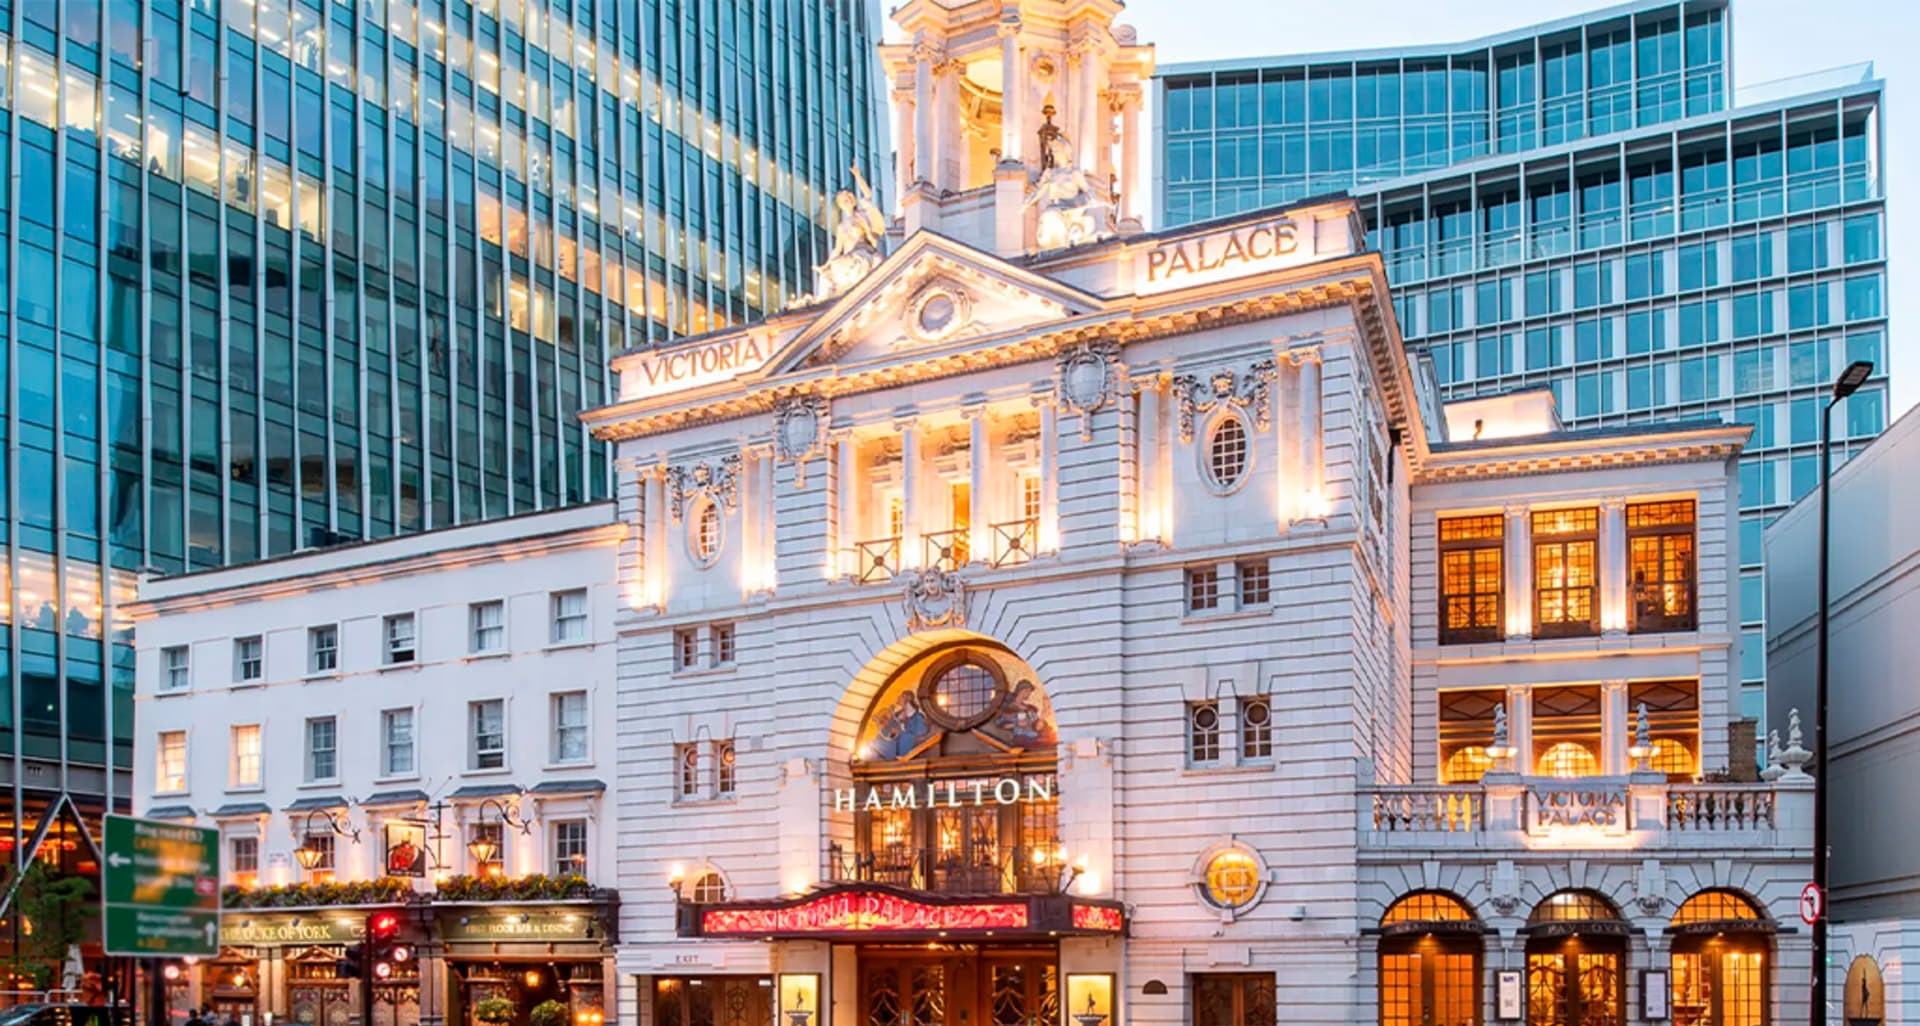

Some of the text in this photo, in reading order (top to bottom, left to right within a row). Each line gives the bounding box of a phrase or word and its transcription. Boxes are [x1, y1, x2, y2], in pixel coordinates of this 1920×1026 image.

[1147, 222, 1298, 282] PALACE
[641, 336, 764, 386] VICTORIA
[834, 776, 1053, 814] HAMILTON
[1533, 791, 1625, 807] VICTORIA
[1537, 809, 1617, 827] PALACE
[763, 896, 962, 930] VICTORIA PALACE
[242, 925, 277, 941] DUKE
[278, 925, 297, 940] OF
[297, 924, 332, 940] YORK
